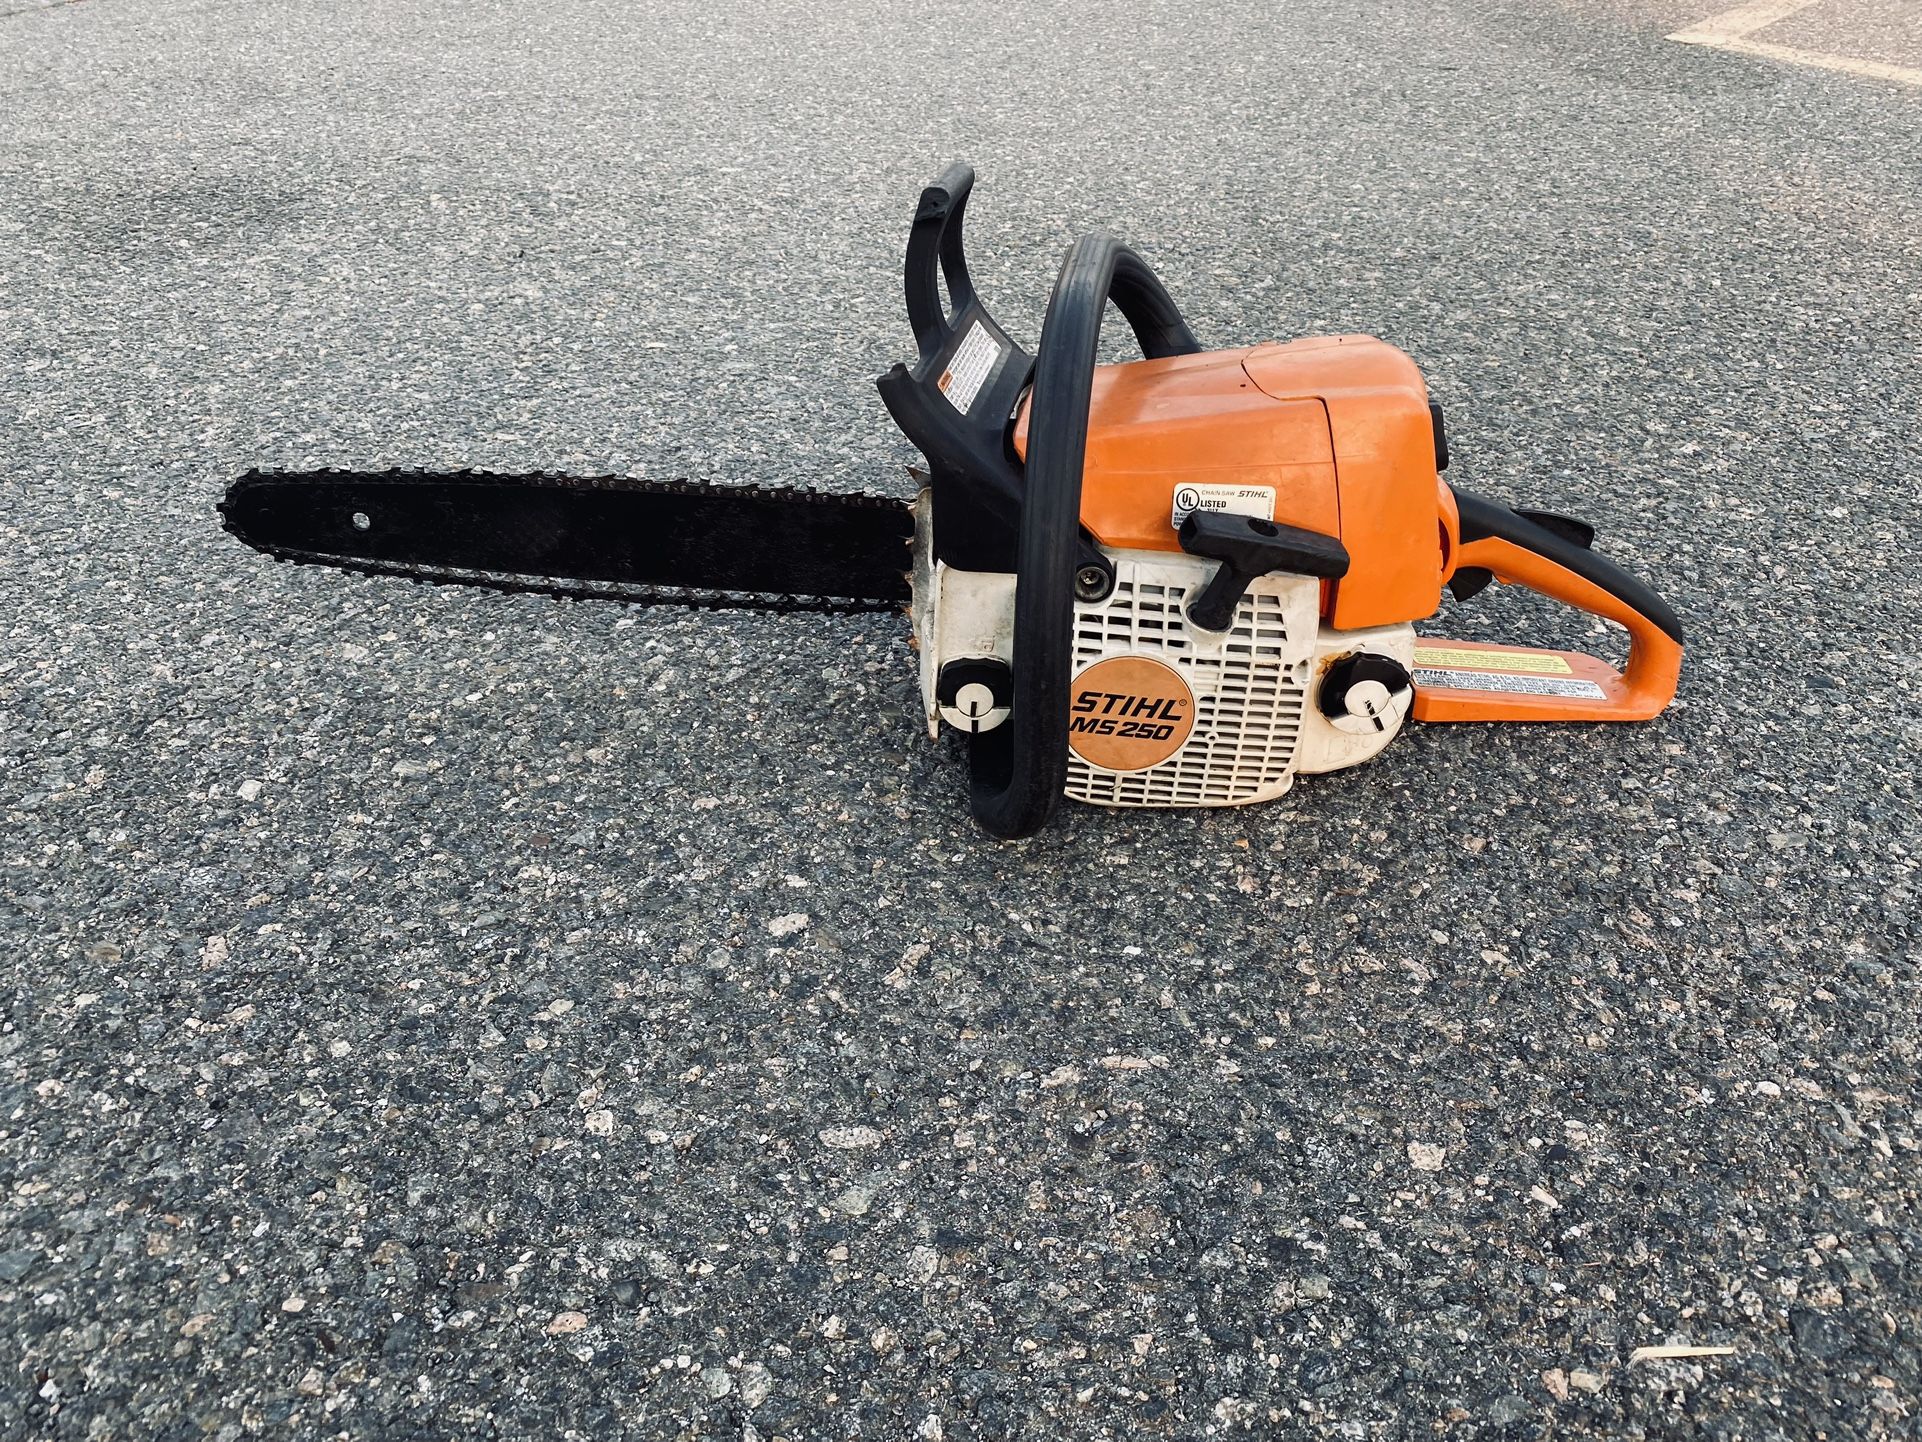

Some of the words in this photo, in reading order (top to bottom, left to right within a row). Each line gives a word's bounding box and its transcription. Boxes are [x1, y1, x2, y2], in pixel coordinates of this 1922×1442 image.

[1182, 493, 1194, 507] UL
[1237, 490, 1267, 498] STIHL
[1200, 500, 1227, 508] LISTED
[1072, 691, 1183, 721] STIHL
[1069, 716, 1119, 735] MS
[1116, 721, 1175, 741] 250
